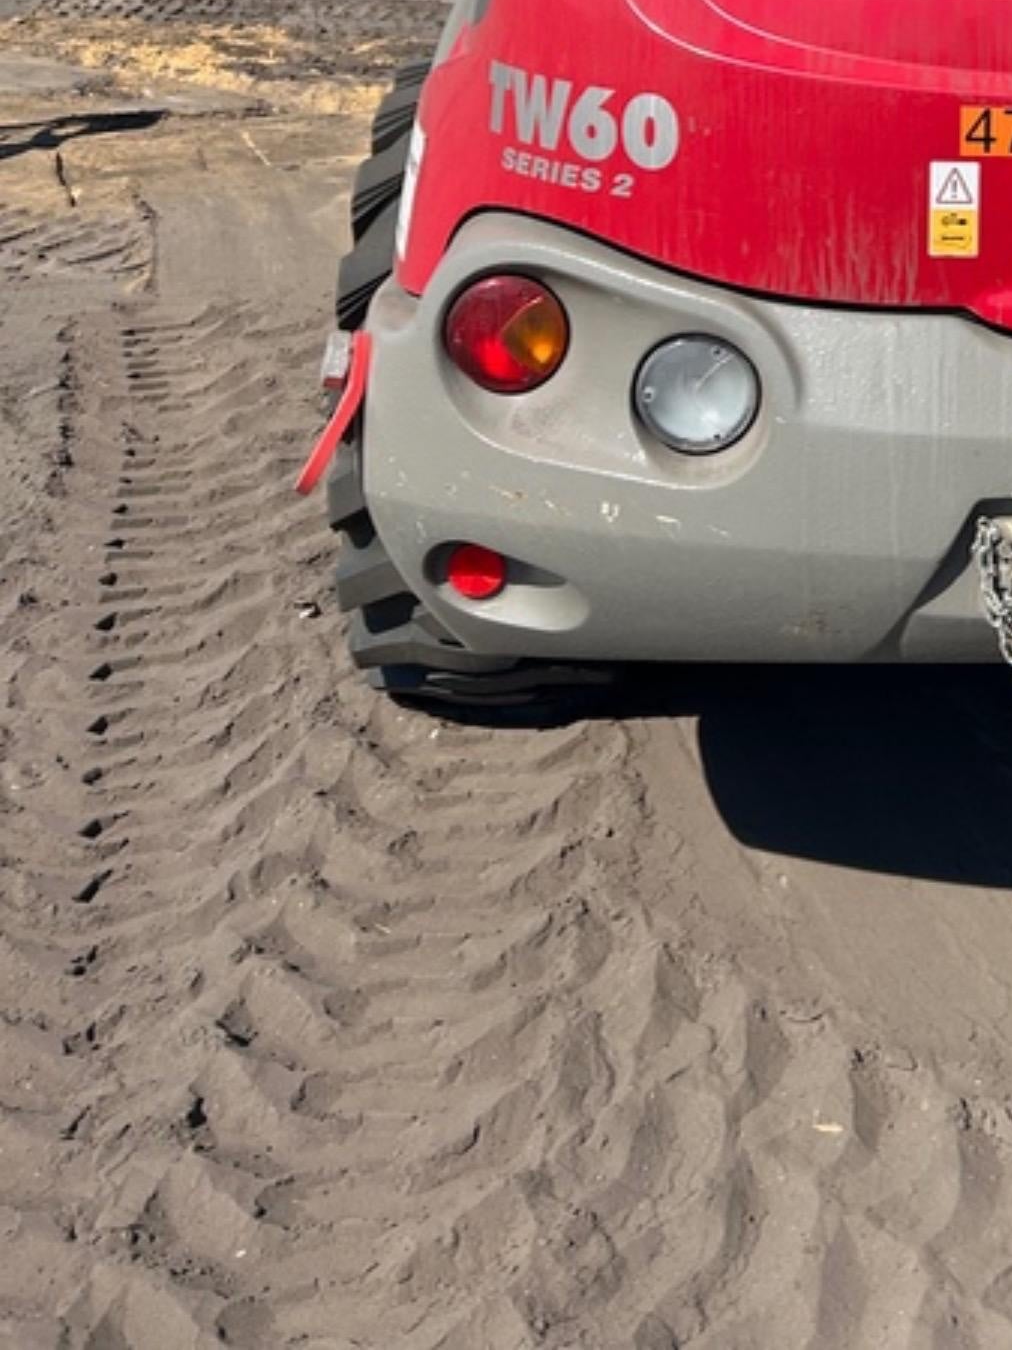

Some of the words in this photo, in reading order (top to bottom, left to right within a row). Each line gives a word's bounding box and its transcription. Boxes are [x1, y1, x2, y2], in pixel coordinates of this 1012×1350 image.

[488, 59, 681, 171] TW60
[501, 147, 602, 192] SERIES
[609, 173, 635, 199] 2
